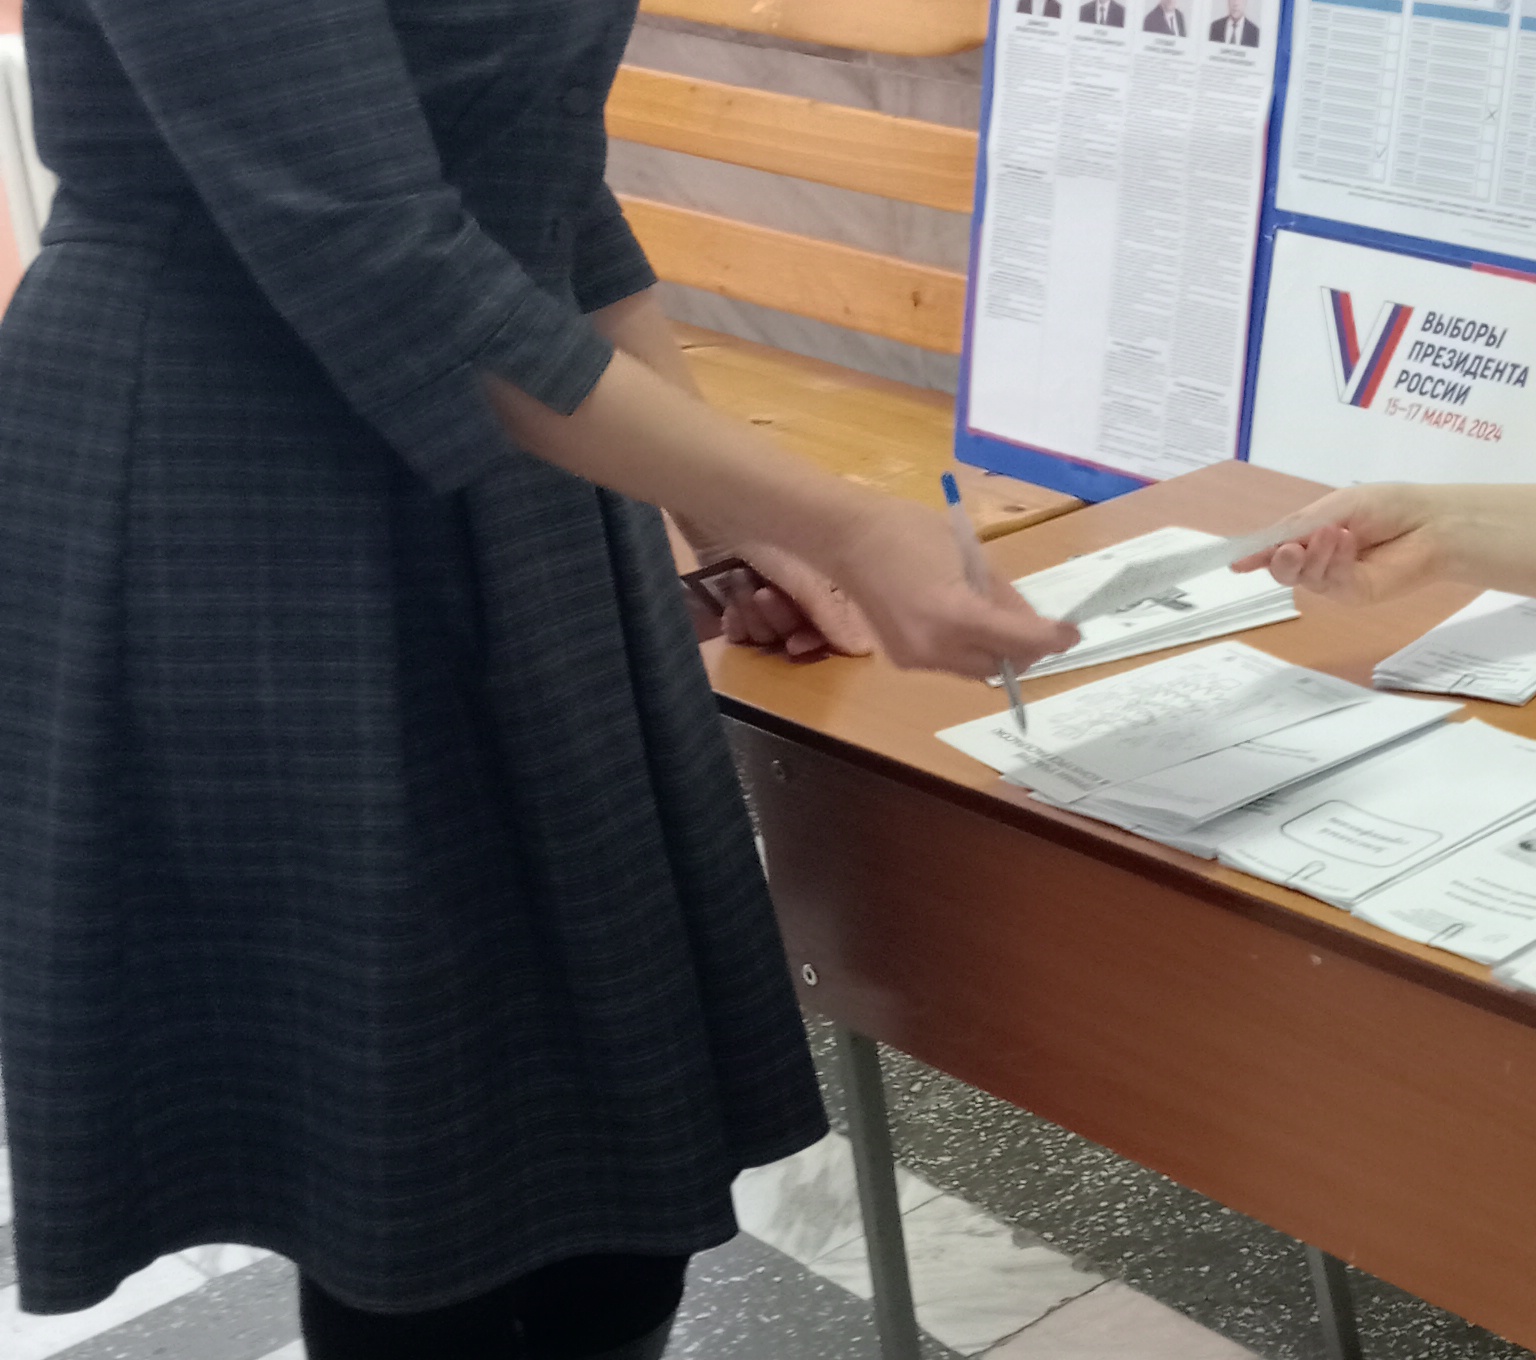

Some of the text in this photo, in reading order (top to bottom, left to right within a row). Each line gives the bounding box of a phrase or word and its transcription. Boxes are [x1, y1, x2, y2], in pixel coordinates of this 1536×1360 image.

[1421, 311, 1508, 349] ВЫБОРЫ
[1407, 340, 1529, 388] ПРЕЗИДЕНТА
[1394, 369, 1472, 406] РОССИИ
[1422, 407, 1467, 434] МАРТА
[1467, 419, 1504, 443] 2024
